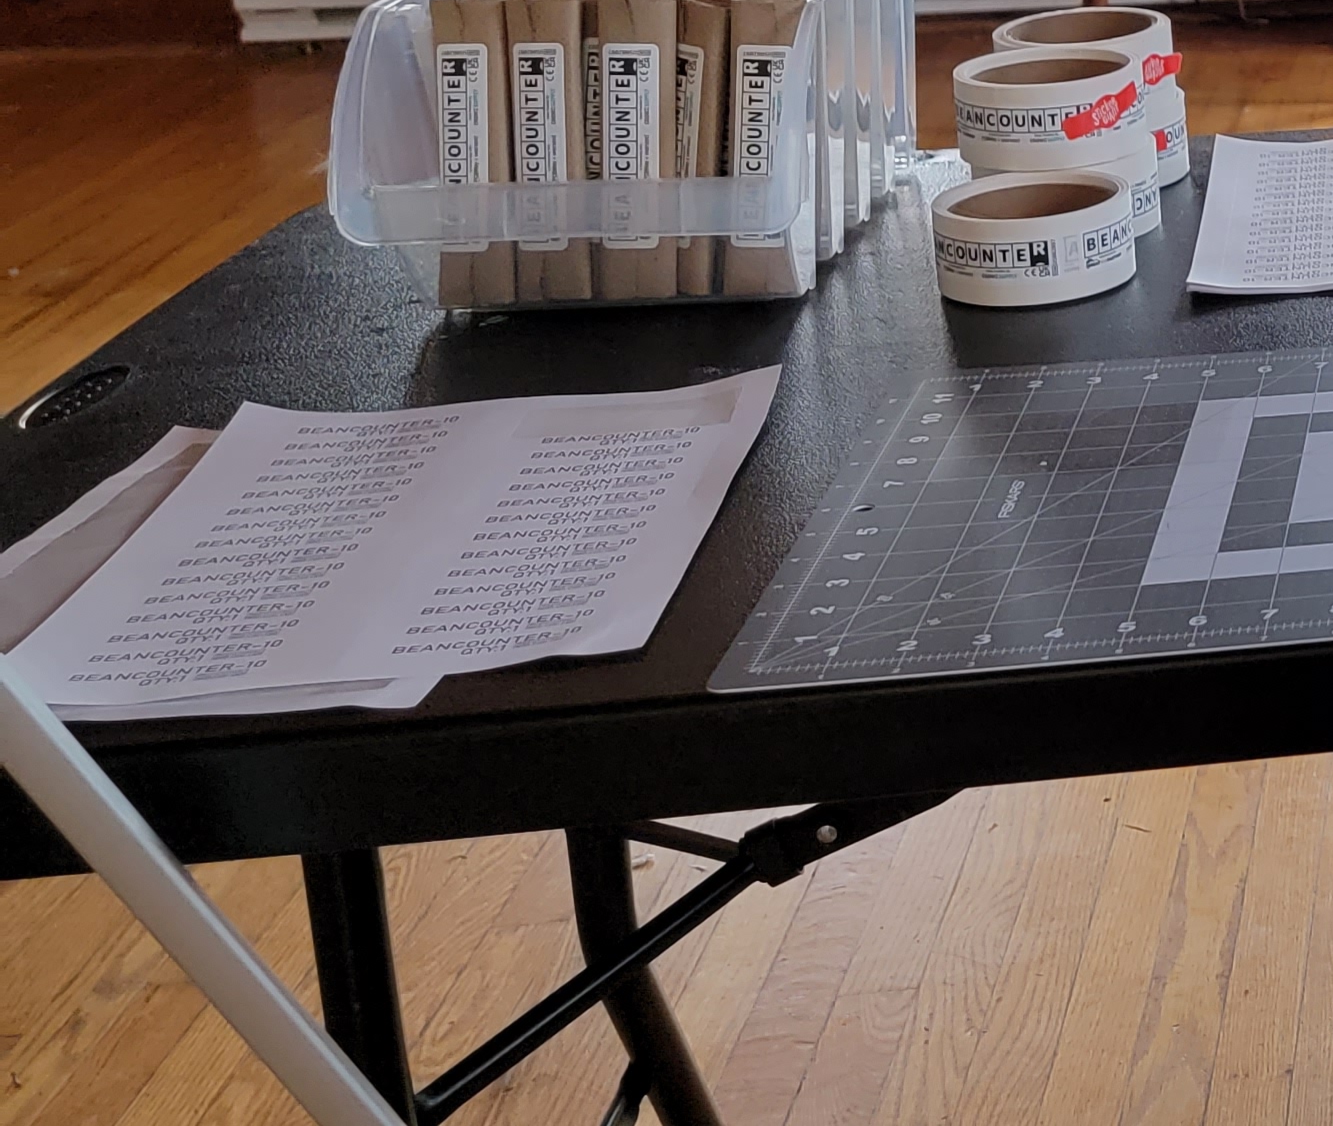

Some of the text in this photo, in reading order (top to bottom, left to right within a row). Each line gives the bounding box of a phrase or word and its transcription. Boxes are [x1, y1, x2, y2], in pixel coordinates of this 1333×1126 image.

[443, 59, 462, 184] COUNTER
[298, 416, 459, 434] BEANCOUNTER-10
[541, 427, 700, 444] BEANCOUNTER-10
[285, 431, 448, 450] BEANCOUNTER-10
[531, 441, 692, 459] BEANCOUNTER-10
[271, 446, 437, 466] BEANCOUNTER-10
[520, 457, 683, 475] BEANCOUNTER-10
[257, 462, 424, 483] BEANCOUNTER-10
[509, 473, 674, 491] BEANCOUNTER-10
[241, 478, 412, 499] BEANCOUNTER-10
[497, 489, 665, 507] BEANCOUNTER-10
[226, 494, 400, 515] BEANCOUNTER-10
[485, 505, 656, 523] BEANCOUNTER-10
[211, 511, 387, 532] BEANCOUNTER-10
[794, 635, 818, 643] 1
[810, 605, 836, 615] 2
[825, 578, 850, 588] 3
[843, 552, 865, 561] 4
[856, 527, 879, 536] 5
[897, 457, 918, 465] 8
[920, 412, 942, 424] 10
[932, 393, 954, 404] 11
[195, 527, 373, 548] BEANCOUNTER-10
[473, 521, 646, 541] BEANCOUNTER-10
[178, 545, 357, 567] BEANCOUNTER-10
[461, 538, 637, 559] BEANCOUNTER-10
[161, 562, 344, 586] BEANCOUNTER-10
[448, 555, 626, 577] BEANCOUNTER-10
[144, 581, 330, 604] BEANCOUNTER-10
[434, 572, 616, 595] BEANCOUNTER-10
[126, 600, 315, 623] BEANCOUNTER-10
[421, 590, 605, 615] BEANCOUNTER-10
[108, 619, 299, 643] BEANCOUNTER-10
[406, 609, 594, 634] BEANCOUNTER-10
[392, 626, 582, 654] BEANCOUNTER-10
[824, 645, 840, 656] 1
[897, 640, 918, 651] 2
[972, 633, 992, 645] 3
[1044, 627, 1065, 638] 4
[1117, 622, 1136, 632] 5
[1189, 615, 1207, 626] 6
[1260, 609, 1279, 620] 7
[88, 640, 283, 662] BEANCOUNTER-10
[69, 660, 267, 682] BEANCOUNTER-10
